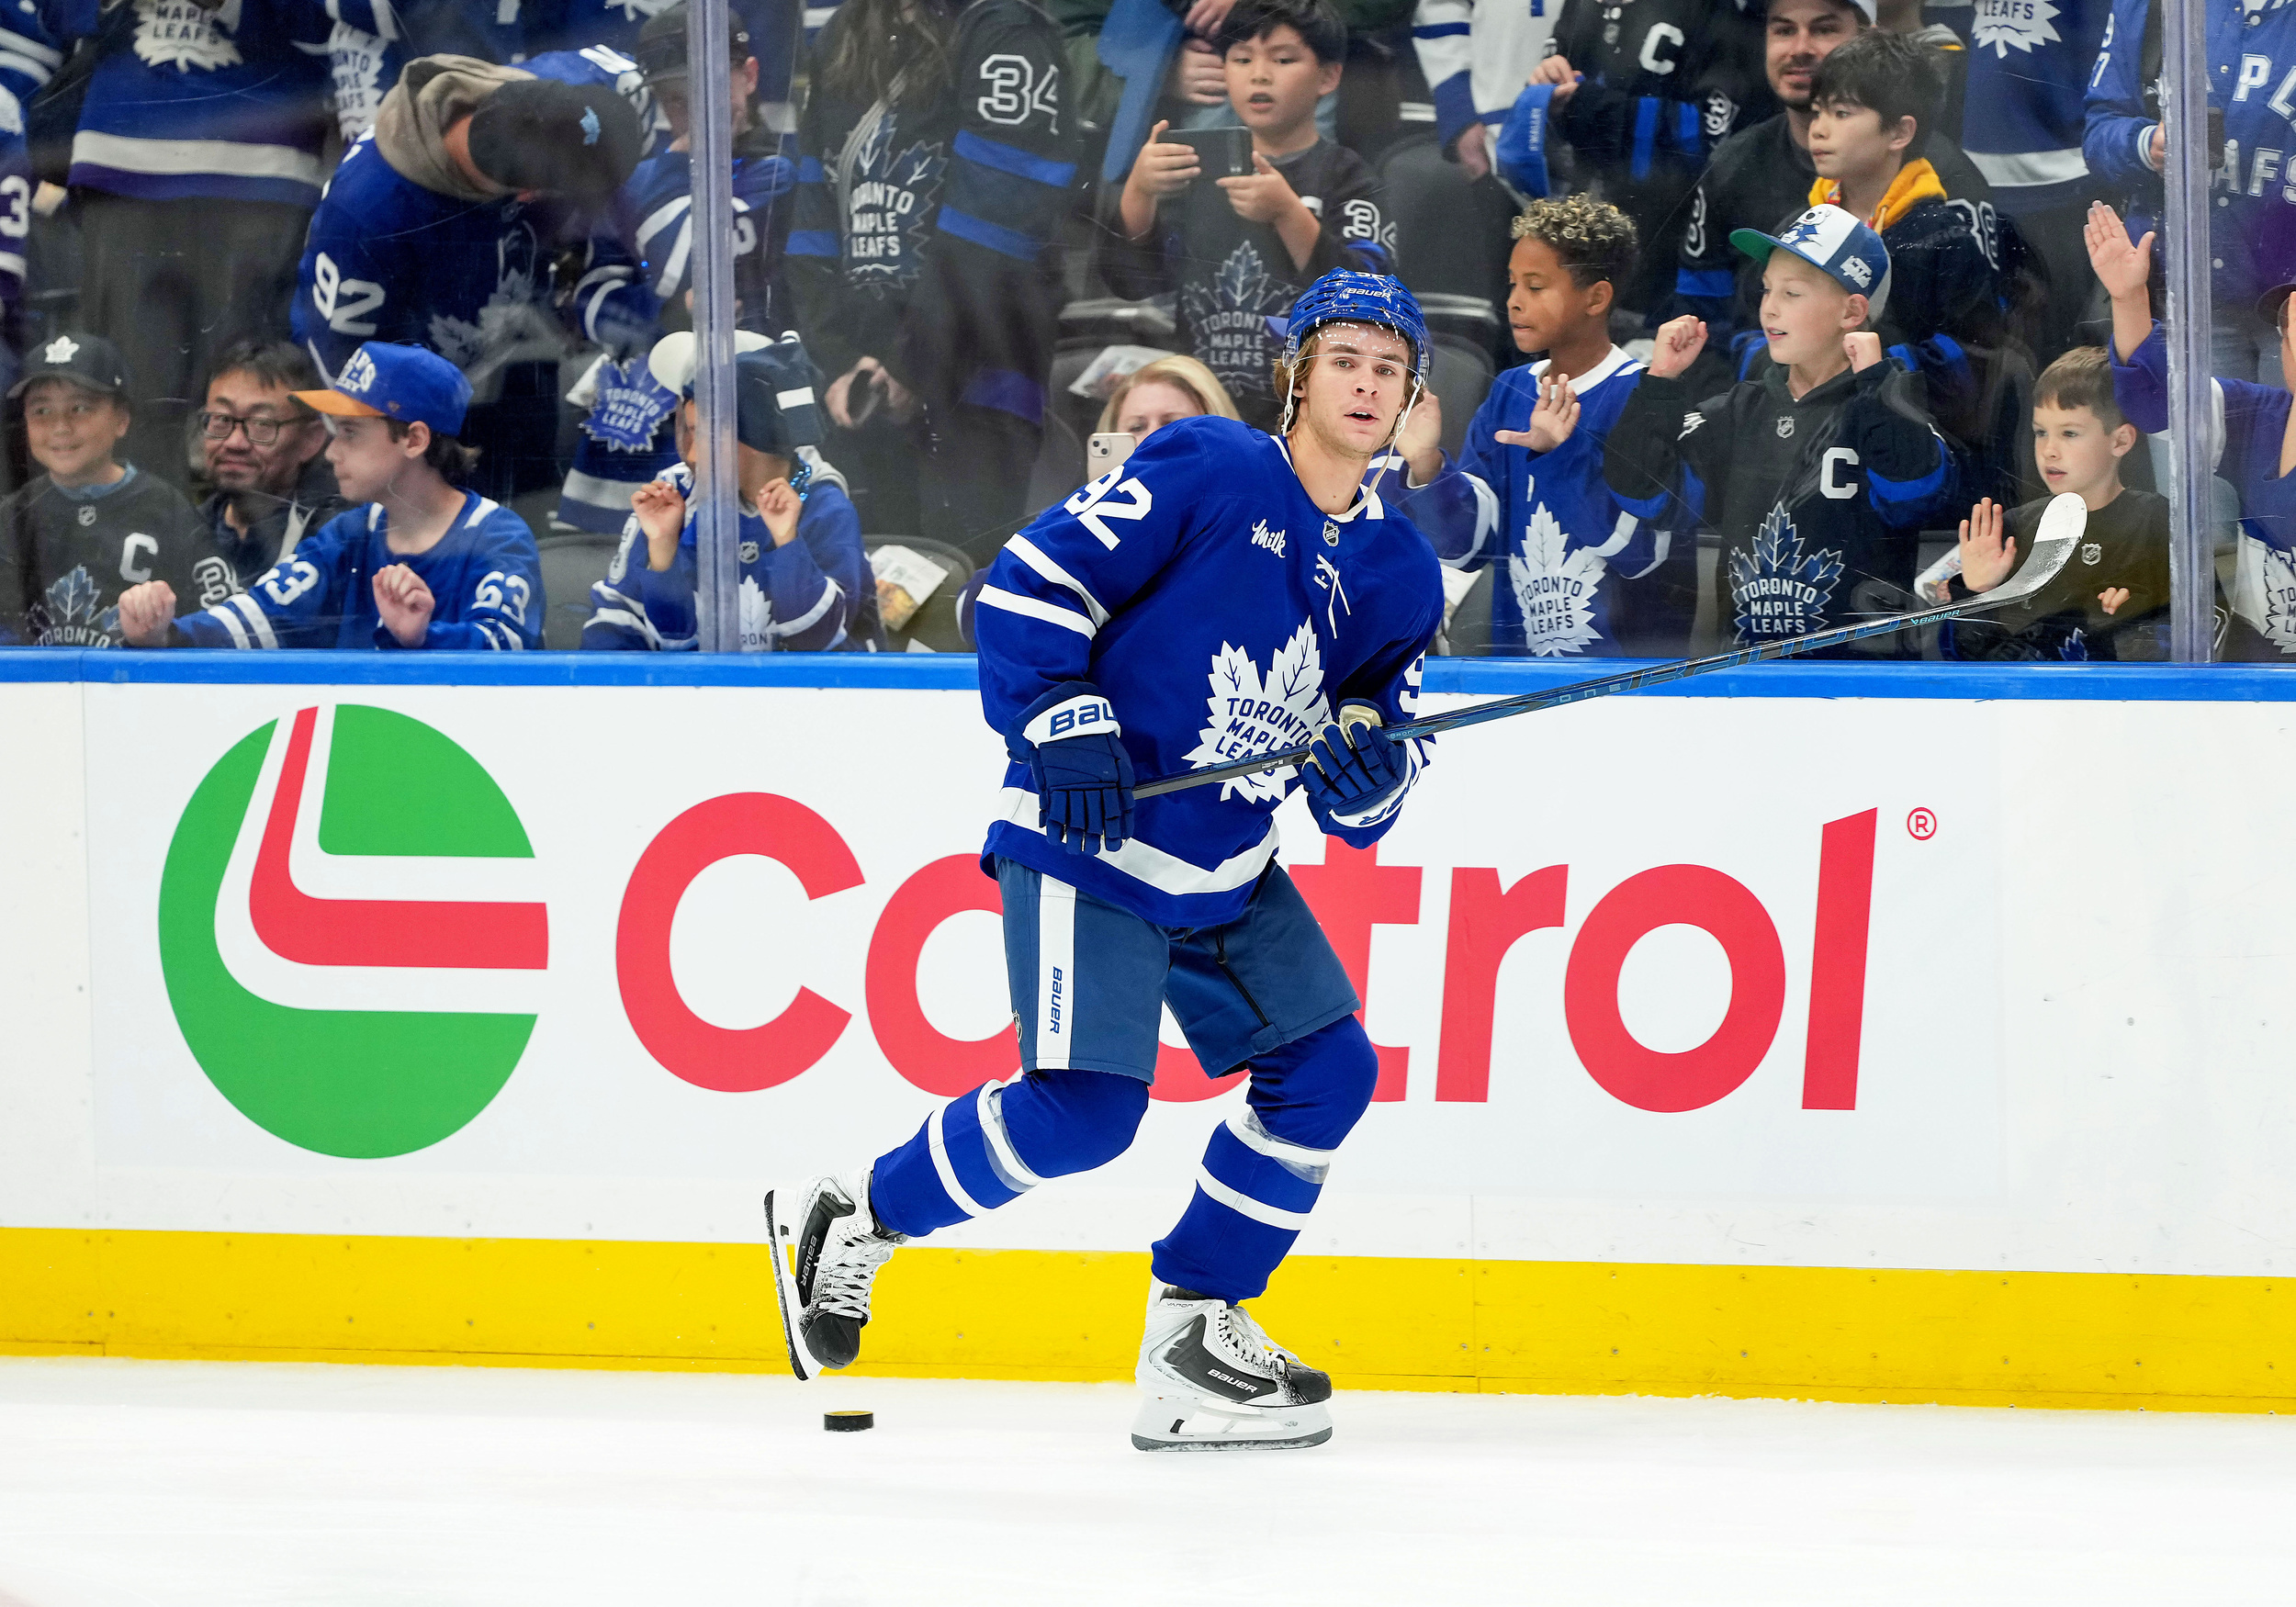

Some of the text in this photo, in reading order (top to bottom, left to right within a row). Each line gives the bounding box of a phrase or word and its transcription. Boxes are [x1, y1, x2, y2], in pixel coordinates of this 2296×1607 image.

[1983, 0, 2035, 20] LEAFS
[1638, 21, 1685, 75] C
[850, 235, 901, 258] LEAFS
[312, 251, 386, 336] 92
[1199, 310, 1273, 338] TORONT
[1210, 333, 1266, 350] MAPLE
[1209, 349, 1266, 367] LEAFS
[605, 387, 661, 418] TORONTO
[607, 401, 647, 422] MAPLE
[601, 410, 643, 435] LEAFS
[1819, 446, 1860, 500] C
[1063, 464, 1154, 552] 92
[1251, 518, 1287, 558] Milk
[119, 533, 159, 583] C
[1521, 575, 1583, 606] TORONTO
[1739, 578, 1818, 605] TORONTO
[1528, 596, 1572, 618] MAPLE
[1750, 601, 1806, 617] MAPLE
[1530, 613, 1574, 635] LEAFS
[1750, 618, 1806, 634] LEAFS
[1226, 697, 1313, 747] TORONTO
[615, 791, 1878, 1114] Catrol
[1049, 965, 1064, 1035] BAUER
[799, 1234, 818, 1287] BAUER
[1206, 1367, 1259, 1394] BAUER
